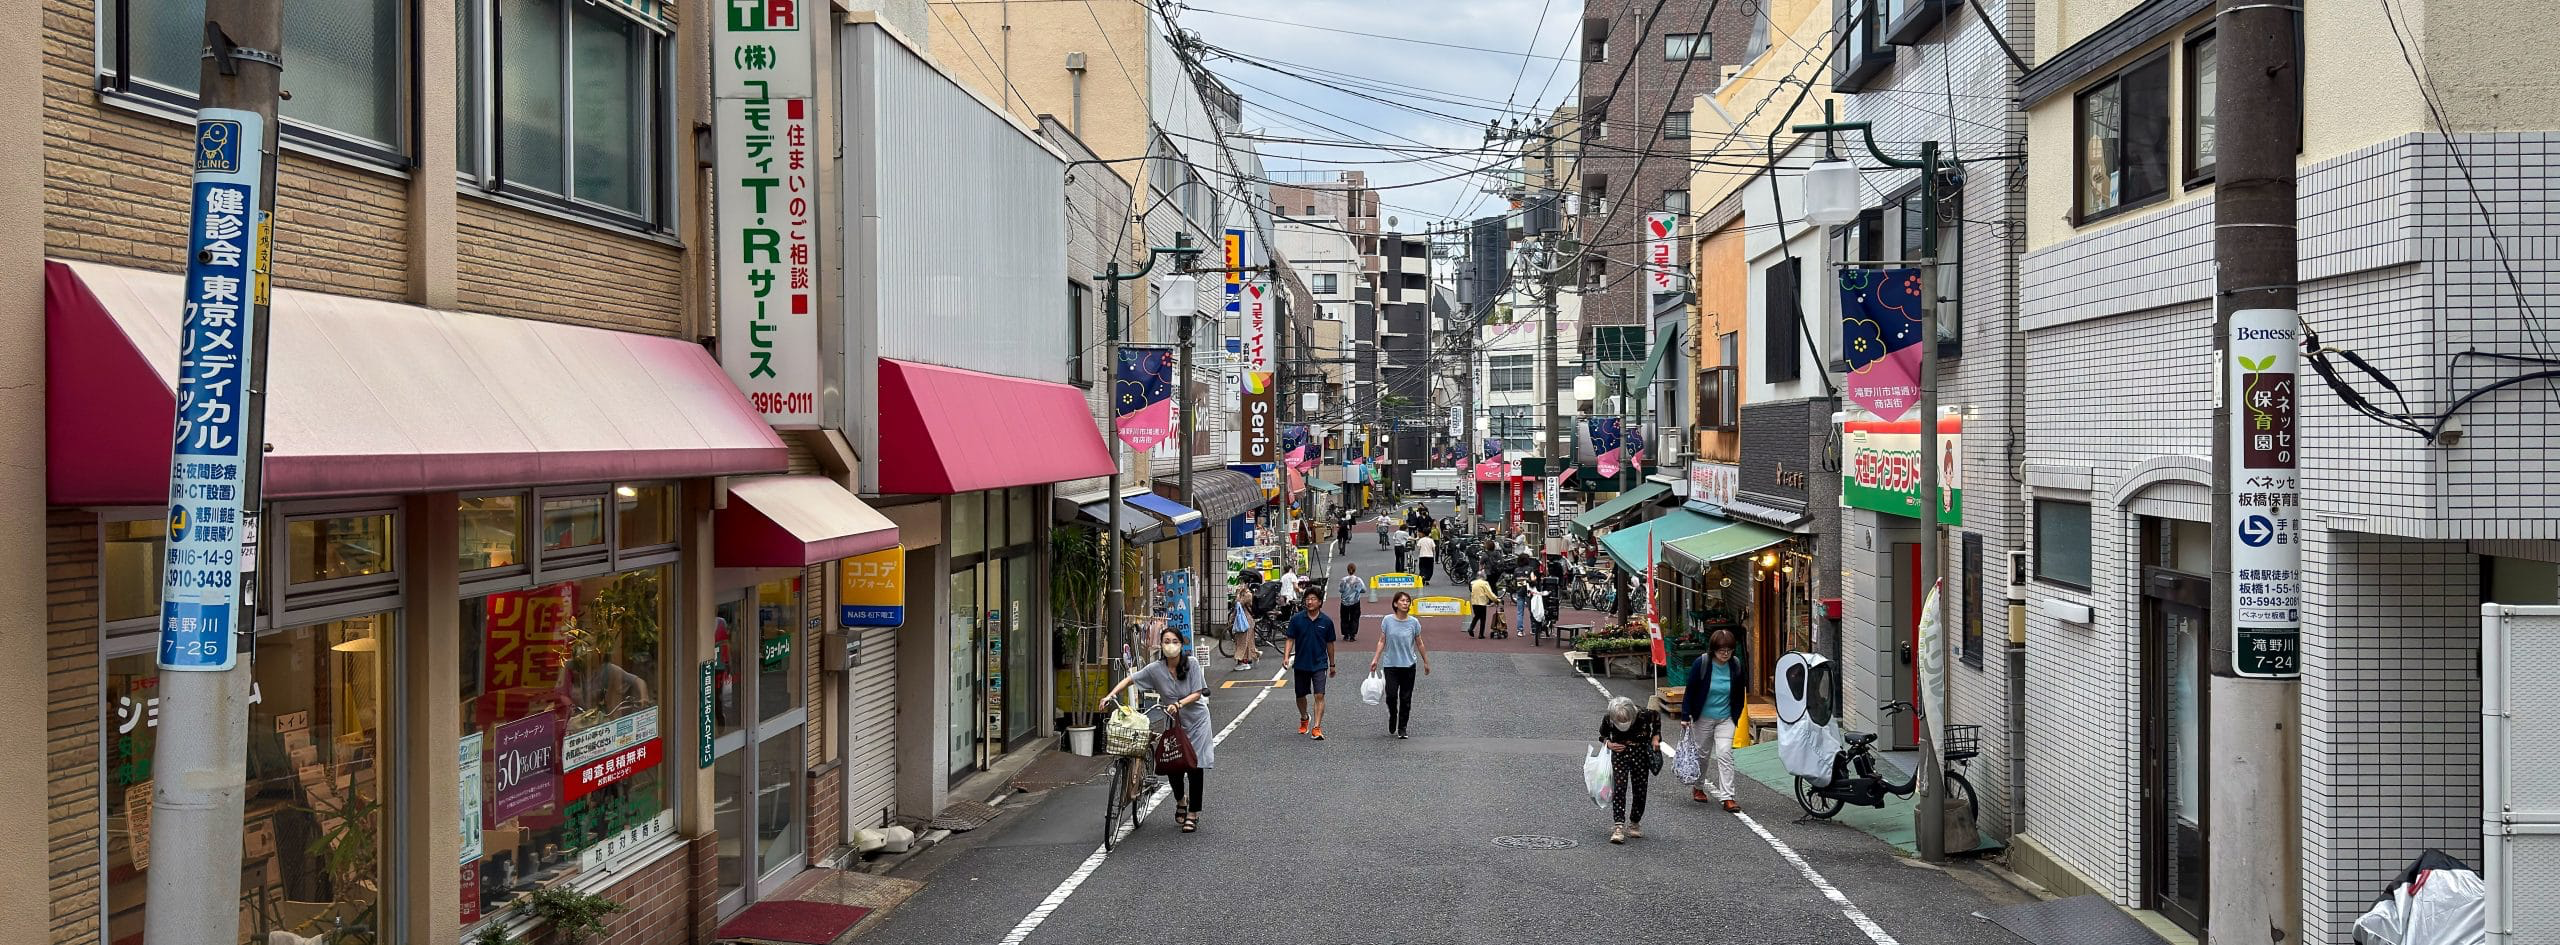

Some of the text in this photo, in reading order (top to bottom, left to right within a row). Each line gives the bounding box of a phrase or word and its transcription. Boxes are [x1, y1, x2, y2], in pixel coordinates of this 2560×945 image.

[733, 0, 794, 27] TR
[196, 159, 230, 170] CLINIC
[786, 124, 809, 289] 住まいのご相談
[194, 187, 244, 450] 健診会 東京メディカル
[2237, 326, 2296, 341] Benesse
[175, 299, 199, 445] クリニック
[1853, 386, 1918, 398] 滝野川市場通り
[1874, 398, 1903, 409] 商店街
[2252, 390, 2273, 451] 保育園
[2274, 379, 2291, 464] ベネッセの
[1250, 401, 1271, 457] Seria
[2246, 476, 2295, 490] ベネッセ
[847, 560, 897, 577] ココデ
[847, 579, 895, 589] リフォーム
[847, 611, 866, 619] NAIS
[167, 616, 218, 633] 滝野川
[166, 640, 218, 656] 7-25
[2252, 638, 2294, 652] 滝野川
[2255, 656, 2292, 669] 7-24
[277, 713, 308, 729] トイレ
[582, 746, 647, 784] 調査見積無料
